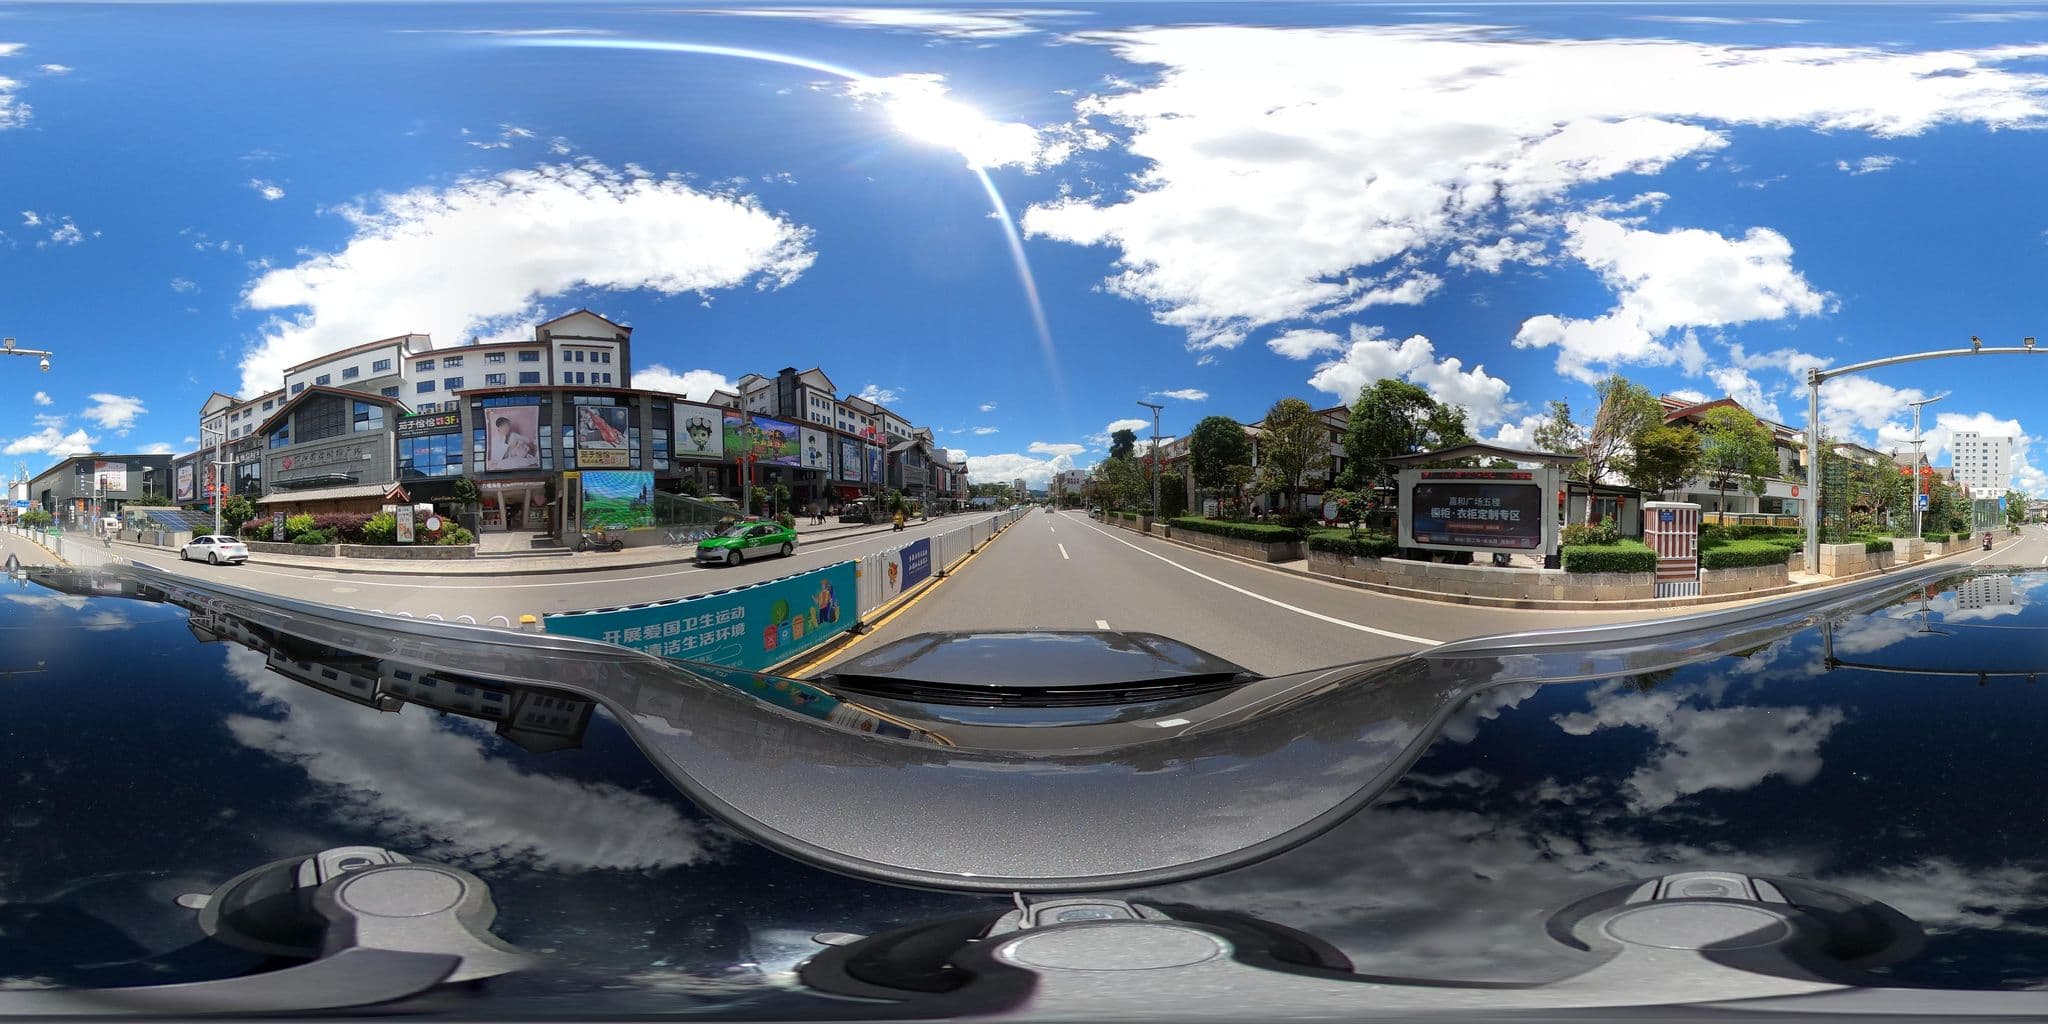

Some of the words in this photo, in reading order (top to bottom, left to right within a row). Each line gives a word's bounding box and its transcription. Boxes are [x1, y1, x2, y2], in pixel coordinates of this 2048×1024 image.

[444, 415, 456, 425] 3F
[603, 606, 746, 646] 开展爱国卫生运动
[630, 622, 746, 658] 清洁生活环境
